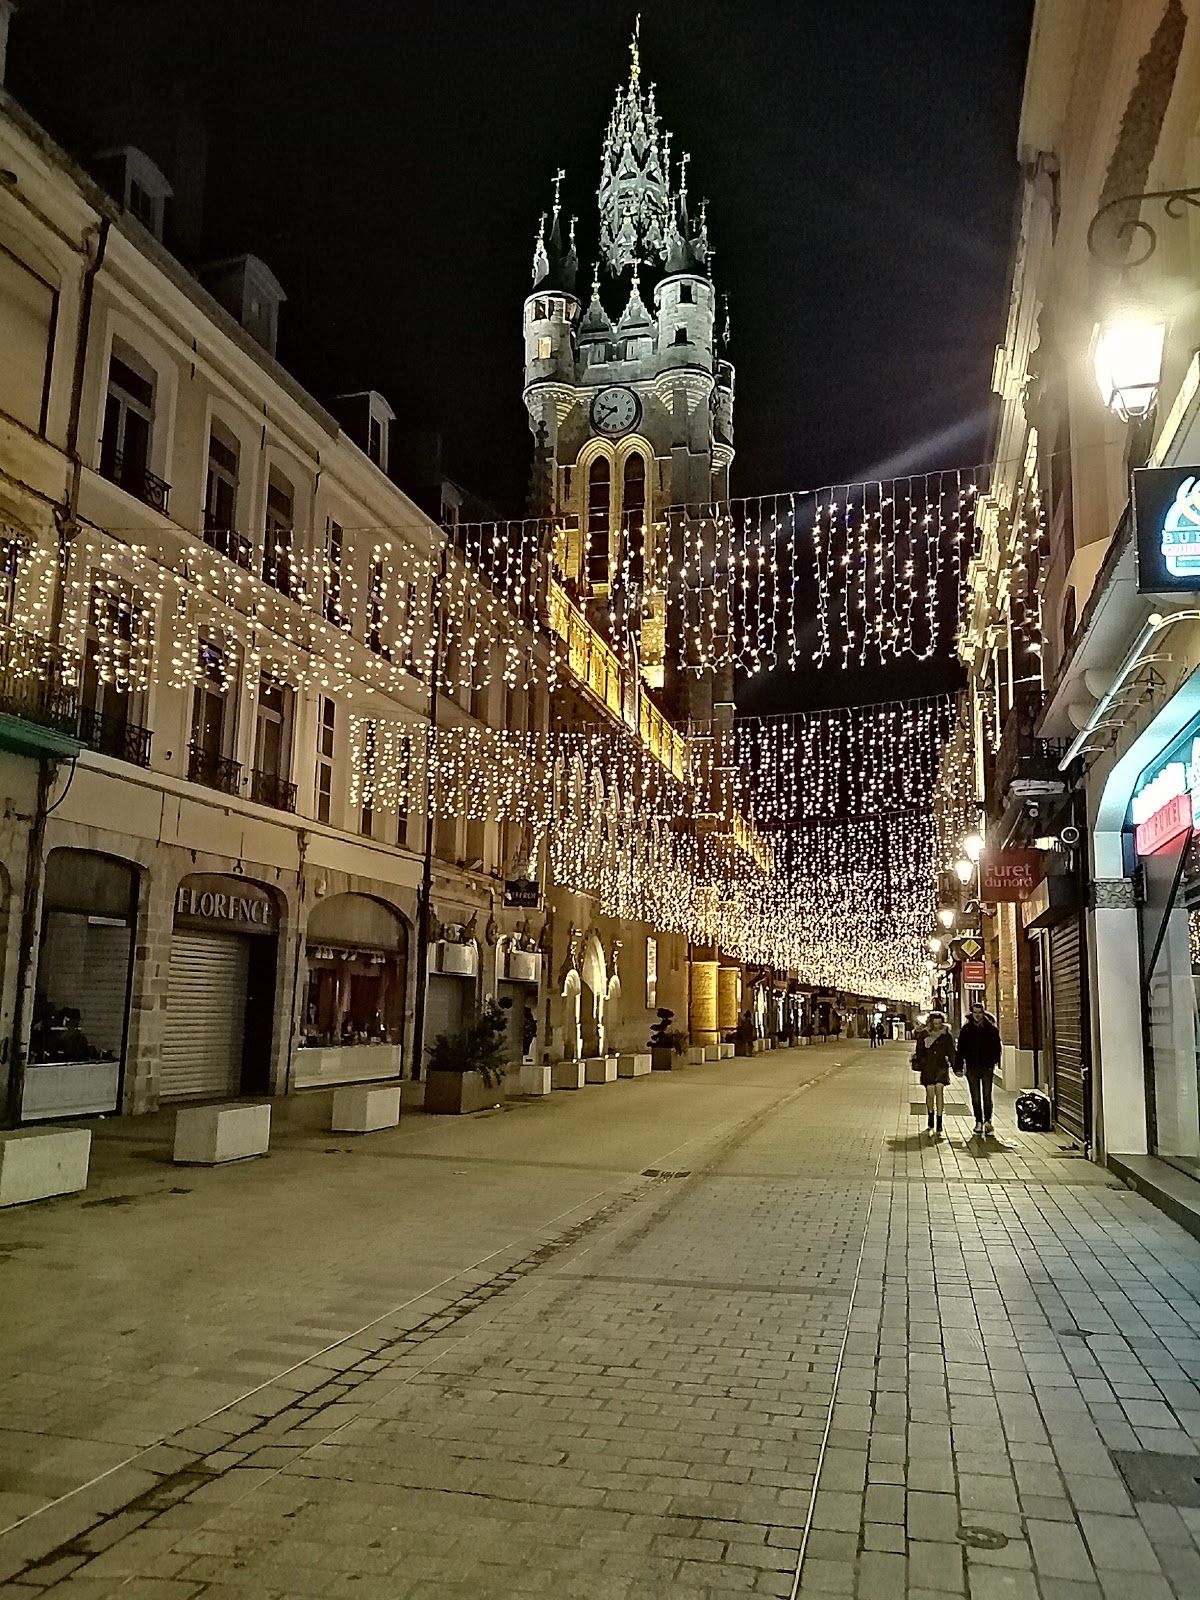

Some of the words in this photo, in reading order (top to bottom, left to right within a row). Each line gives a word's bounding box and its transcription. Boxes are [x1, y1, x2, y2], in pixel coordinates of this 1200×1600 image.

[985, 863, 1032, 877] Furet
[984, 876, 1001, 888] du
[1003, 876, 1033, 888] nord
[177, 888, 272, 924] FLORENCE
